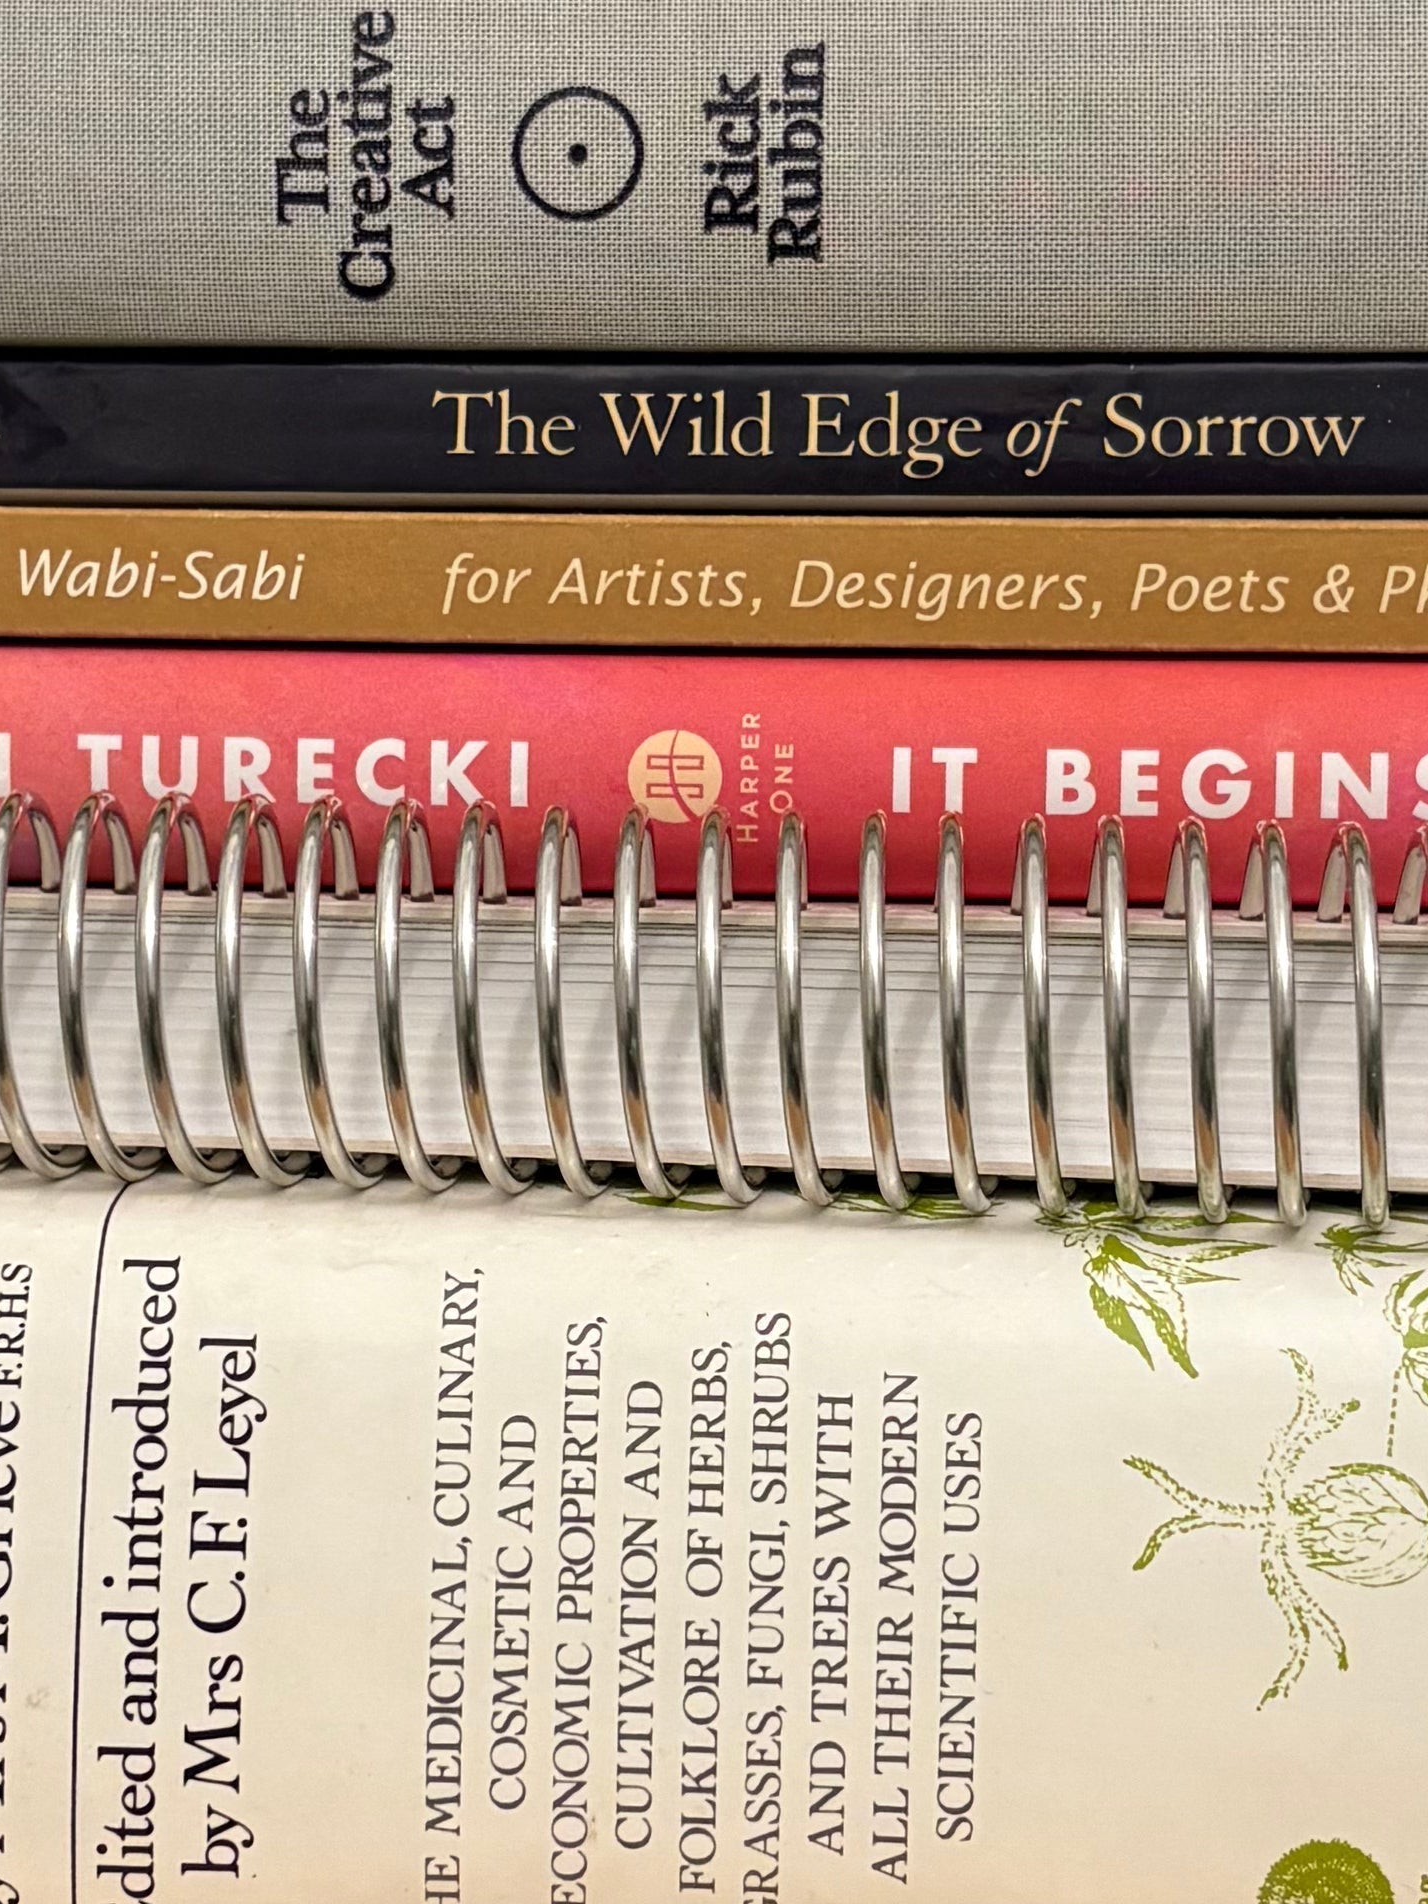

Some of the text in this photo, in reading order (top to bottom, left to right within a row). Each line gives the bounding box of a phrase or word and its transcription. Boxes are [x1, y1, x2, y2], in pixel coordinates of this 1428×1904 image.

[275, 89, 330, 226] The
[336, 11, 398, 304] Creative
[400, 95, 456, 220] Act
[702, 74, 761, 234] Rick
[766, 41, 825, 267] Rubin
[432, 388, 1365, 478] The Wild Edge of Sorrow
[20, 547, 305, 600] Wabi-Sabi
[442, 552, 532, 614] for
[548, 558, 761, 615] Artists,
[790, 560, 1101, 621] Designers,
[1131, 563, 1289, 612] Poets
[1313, 564, 1354, 613] &
[77, 734, 529, 807] TURECKI
[737, 712, 761, 843] HARPER
[770, 744, 794, 813] ONE
[893, 747, 978, 813] IT
[103, 1257, 180, 1591] introduced
[193, 1335, 267, 1496] Leyel
[433, 1269, 483, 1527] CULINARY,
[557, 1317, 606, 1622] PROPERTIES,
[750, 1313, 791, 1504] SHRUBS
[101, 1609, 159, 1725] and
[489, 1415, 536, 1810] COSMETIC AND
[615, 1381, 663, 1850] CULTIVATION AND
[679, 1342, 731, 1893] FOLKLORE OF HERBS,
[747, 1520, 789, 1688] FUNGI,
[808, 1394, 853, 1856] AND TREES WITH
[871, 1373, 918, 1884] ALL THEIR MODERN
[936, 1413, 982, 1841] SCIENTIFIC USES
[183, 1654, 243, 1793] Mrs
[425, 1537, 471, 1836] MEDICINAL,
[181, 1805, 254, 1878] by
